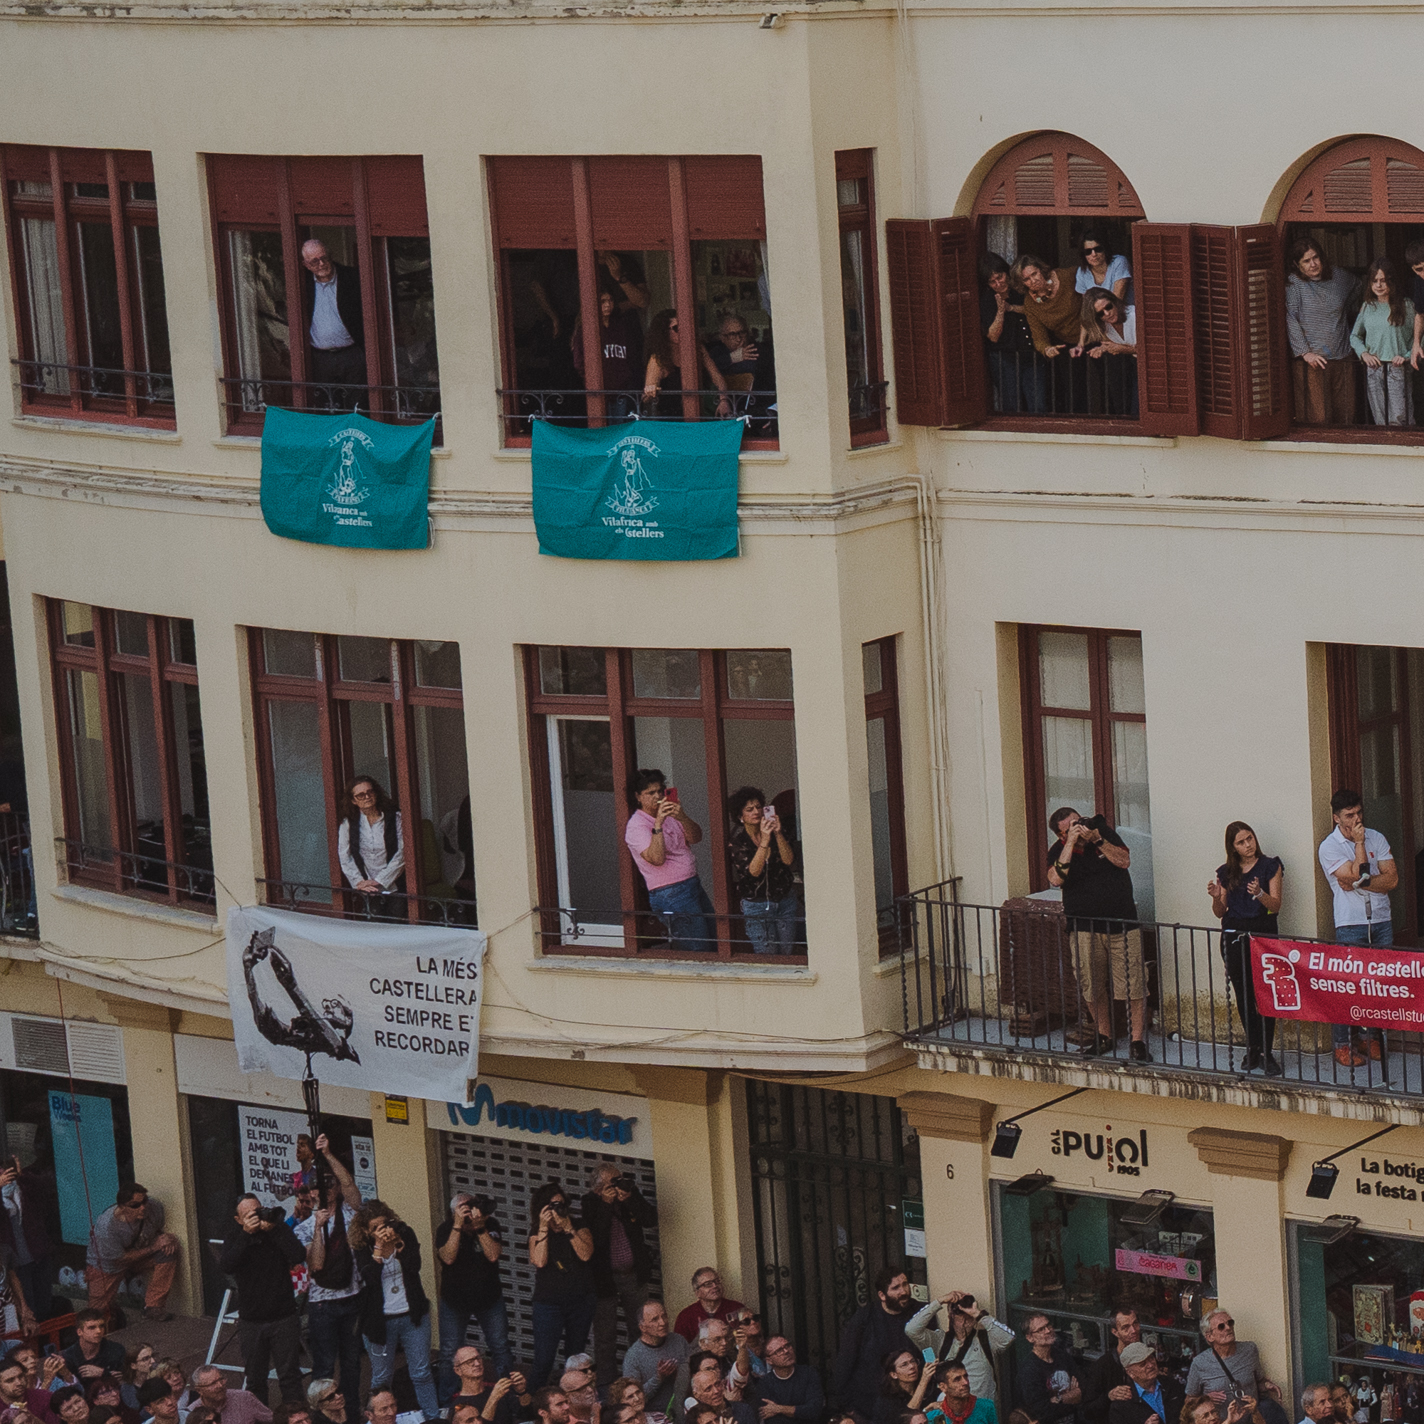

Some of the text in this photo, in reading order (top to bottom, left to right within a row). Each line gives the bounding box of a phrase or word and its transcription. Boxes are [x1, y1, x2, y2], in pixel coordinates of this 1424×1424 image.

[416, 956, 477, 980] LA MÉS
[1308, 952, 1324, 970] El
[1328, 955, 1363, 974] món
[369, 978, 477, 1006] CASTELLERA
[1309, 977, 1415, 998] sense filtres.
[384, 1005, 474, 1033] SEMPRE E
[245, 1115, 279, 1130] TORNA
[495, 1100, 638, 1145] movistar
[246, 1129, 295, 1145] EL FUTBOL
[1050, 1129, 1062, 1155] CAL
[248, 1142, 287, 1157] AMB TOT
[249, 1155, 260, 1166] EL
[261, 1157, 281, 1170] QUE
[1117, 1165, 1140, 1176] 1905
[1361, 1157, 1380, 1174] La
[250, 1168, 294, 1184] DEMANES
[946, 1164, 955, 1180] 6
[251, 1181, 263, 1192] AL
[1356, 1178, 1371, 1195] la
[1375, 1180, 1417, 1201] festa
